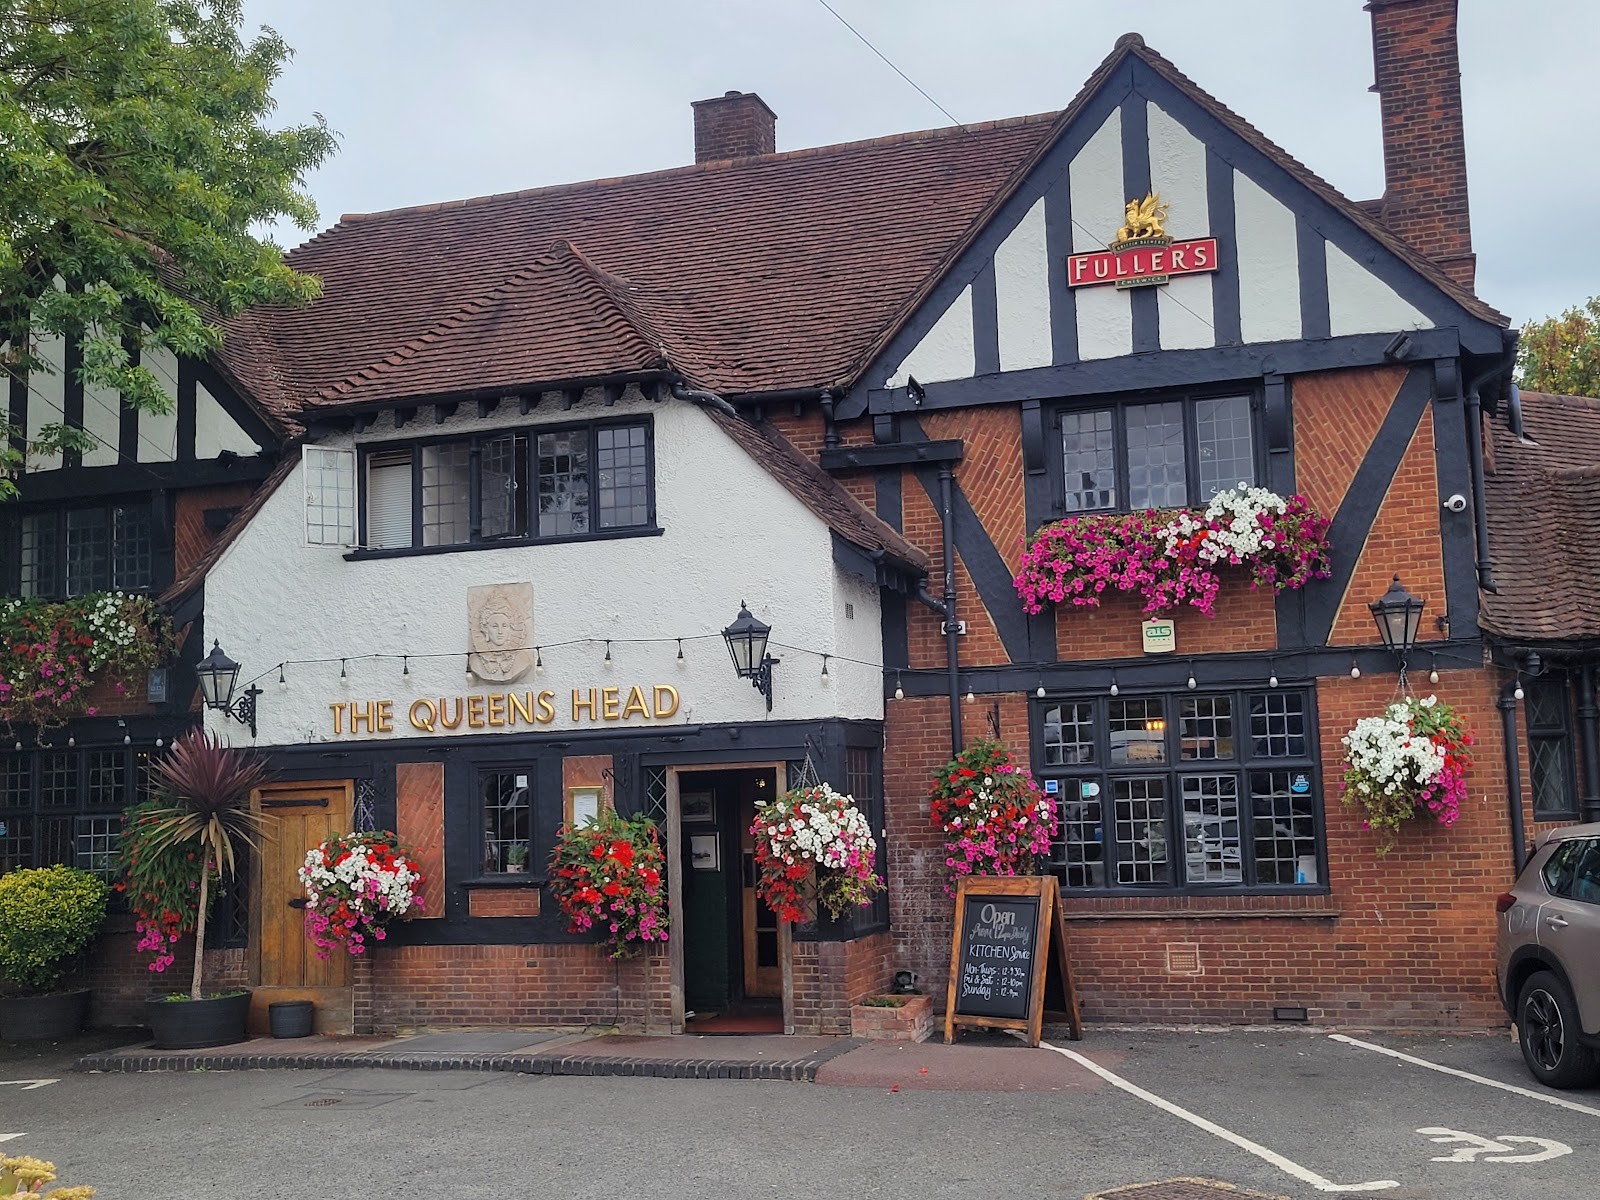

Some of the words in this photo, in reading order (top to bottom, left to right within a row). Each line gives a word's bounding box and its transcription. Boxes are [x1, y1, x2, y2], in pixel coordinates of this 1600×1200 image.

[1075, 244, 1207, 280] FULLER'S
[1121, 276, 1162, 286] CHISWICK
[329, 699, 394, 734] THE
[409, 689, 556, 733] QUEENS
[571, 684, 681, 722] HEAD
[981, 903, 1016, 929] Open
[969, 944, 1010, 958] KITCHEN
[1008, 945, 1031, 962] Service
[963, 973, 973, 984] Fri
[974, 974, 981, 984] &
